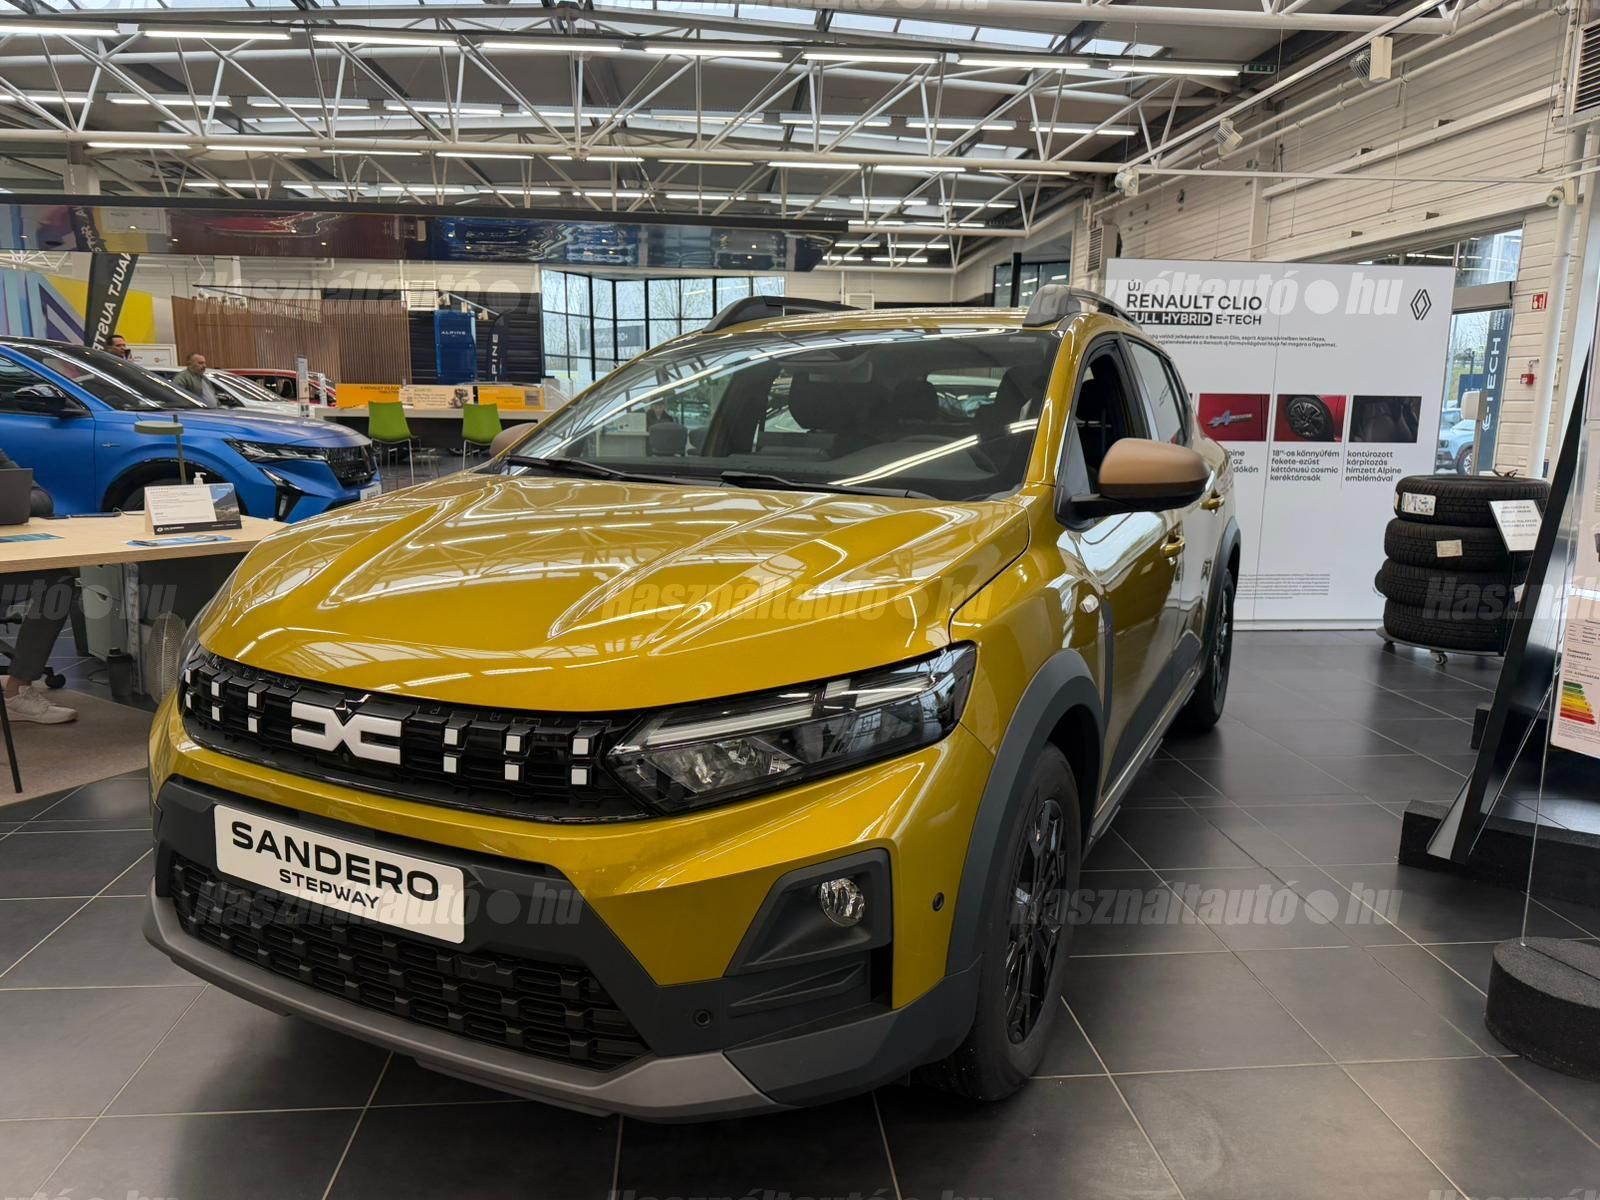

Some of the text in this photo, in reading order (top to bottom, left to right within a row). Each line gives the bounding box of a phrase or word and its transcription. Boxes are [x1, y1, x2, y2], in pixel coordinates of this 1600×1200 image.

[1127, 279, 1141, 292] ÚJ
[1126, 293, 1263, 311] RENAULT CLIO
[1161, 312, 1212, 325] HYBRID
[1215, 314, 1262, 326] E-TECH
[491, 333, 499, 383] PINE
[1310, 466, 1339, 474] cosmic
[1376, 466, 1402, 475] Alpine
[231, 820, 439, 902] SANDERO
[278, 868, 380, 910] STEPWAY
